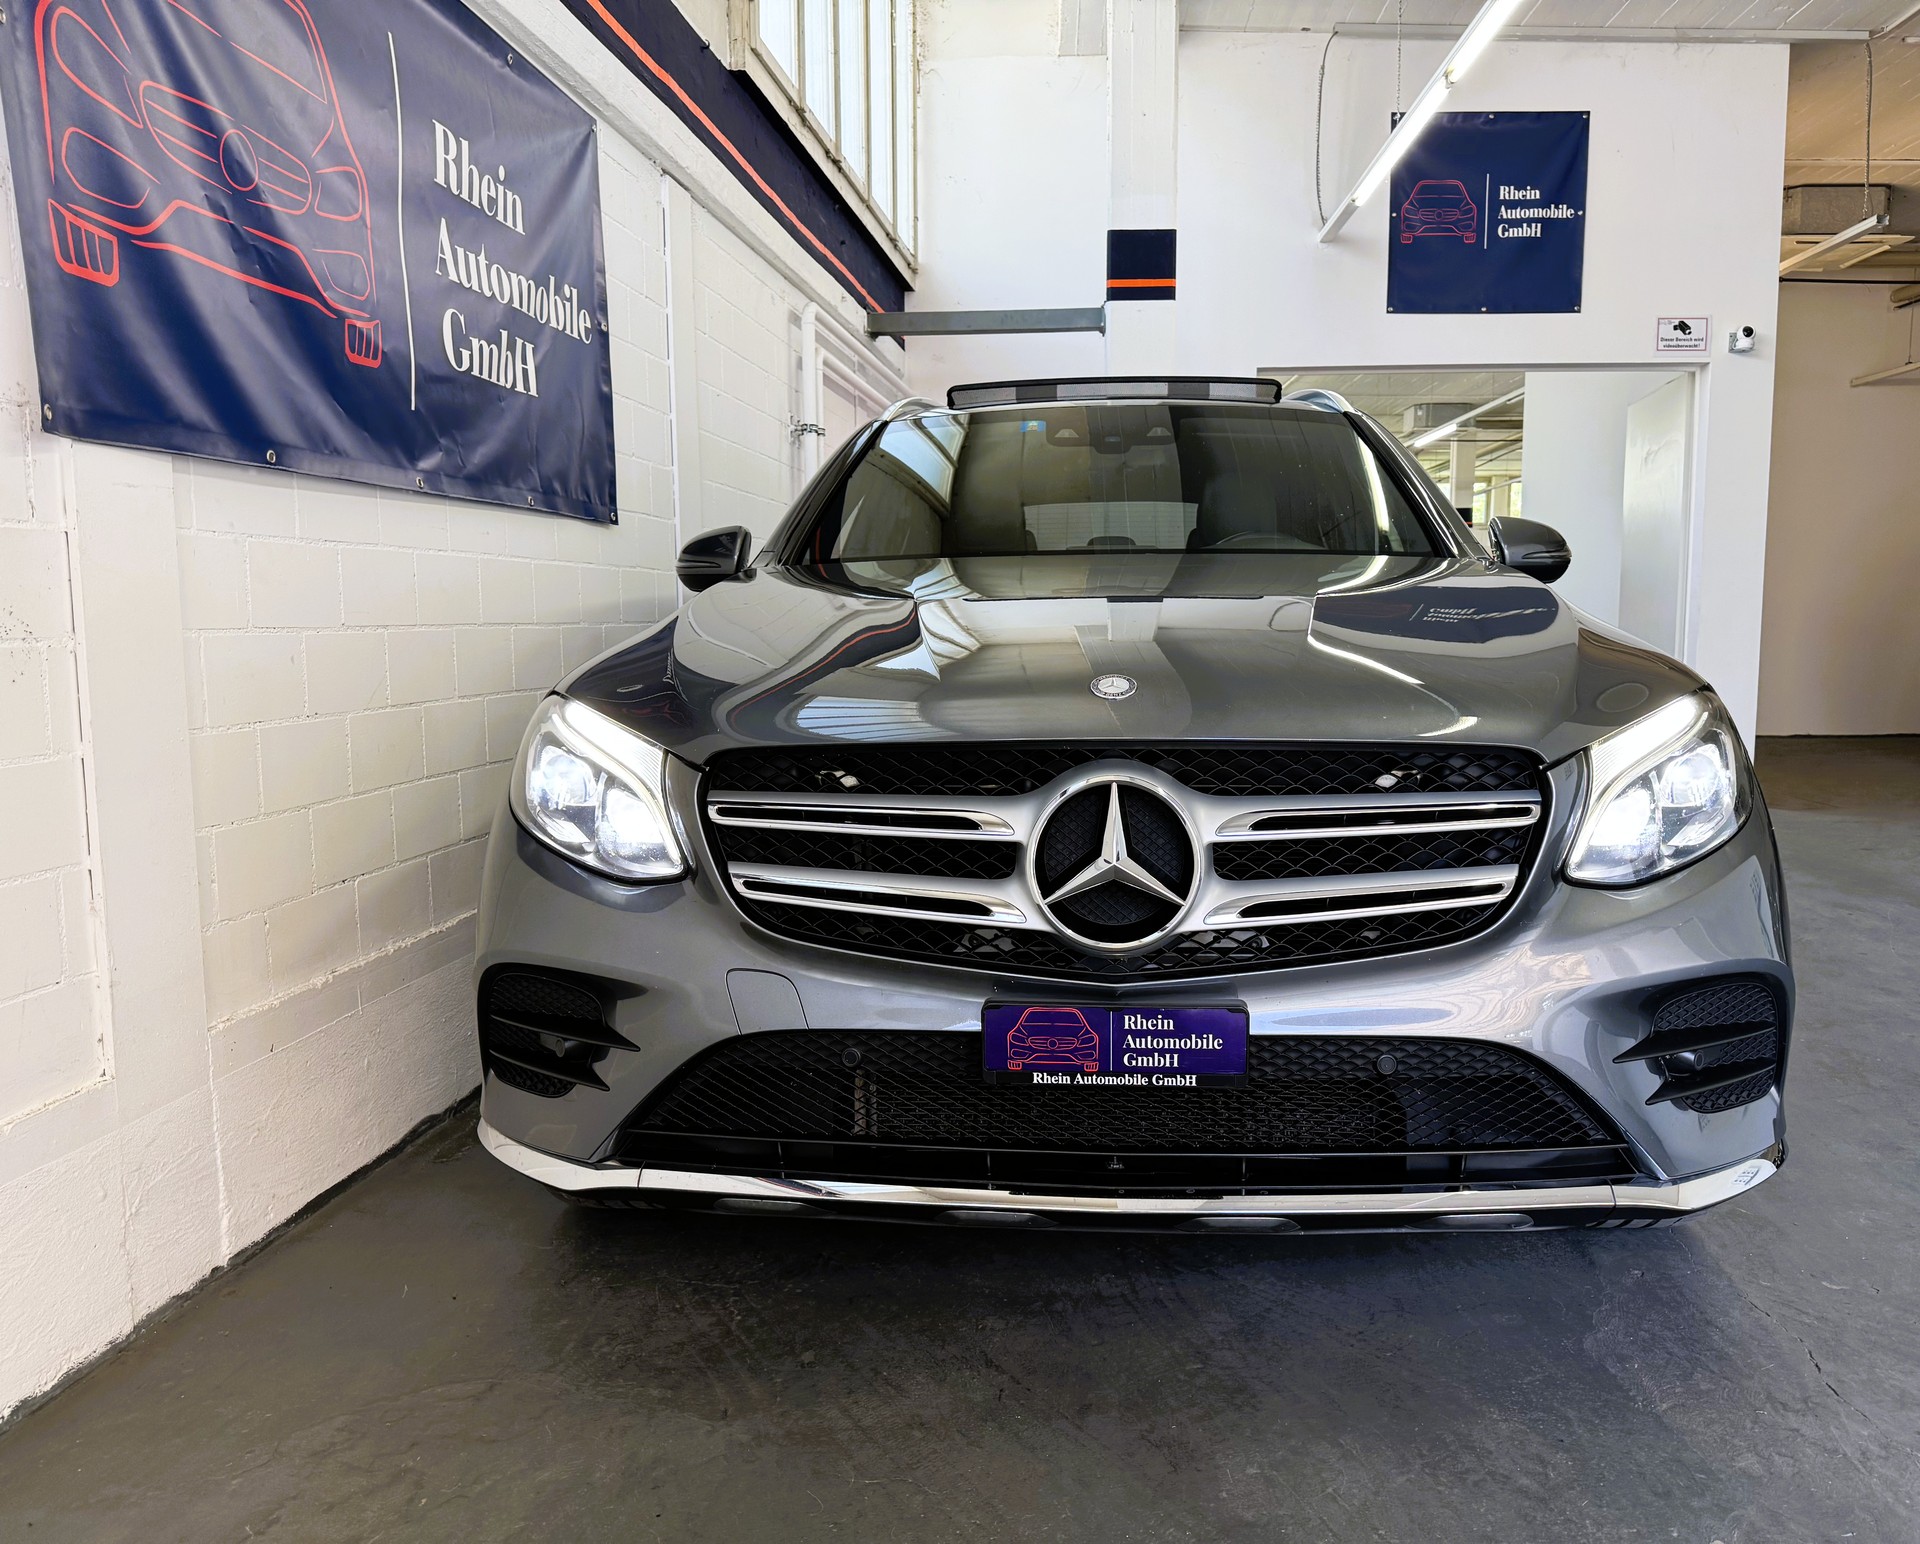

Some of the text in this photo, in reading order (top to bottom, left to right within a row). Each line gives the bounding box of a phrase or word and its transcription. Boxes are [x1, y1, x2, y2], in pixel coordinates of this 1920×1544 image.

[432, 119, 526, 235] Rhein
[1499, 185, 1540, 200] Rhein
[1498, 204, 1575, 219] Automobile
[1497, 223, 1542, 238] GmbH
[435, 217, 593, 344] Automobile
[442, 308, 539, 397] GmbH
[1123, 1014, 1175, 1031] Rhein
[1122, 1033, 1224, 1050] Automobile
[1122, 1052, 1180, 1068] GmbH
[1032, 1072, 1198, 1087] Rhein Automobile GmbH
